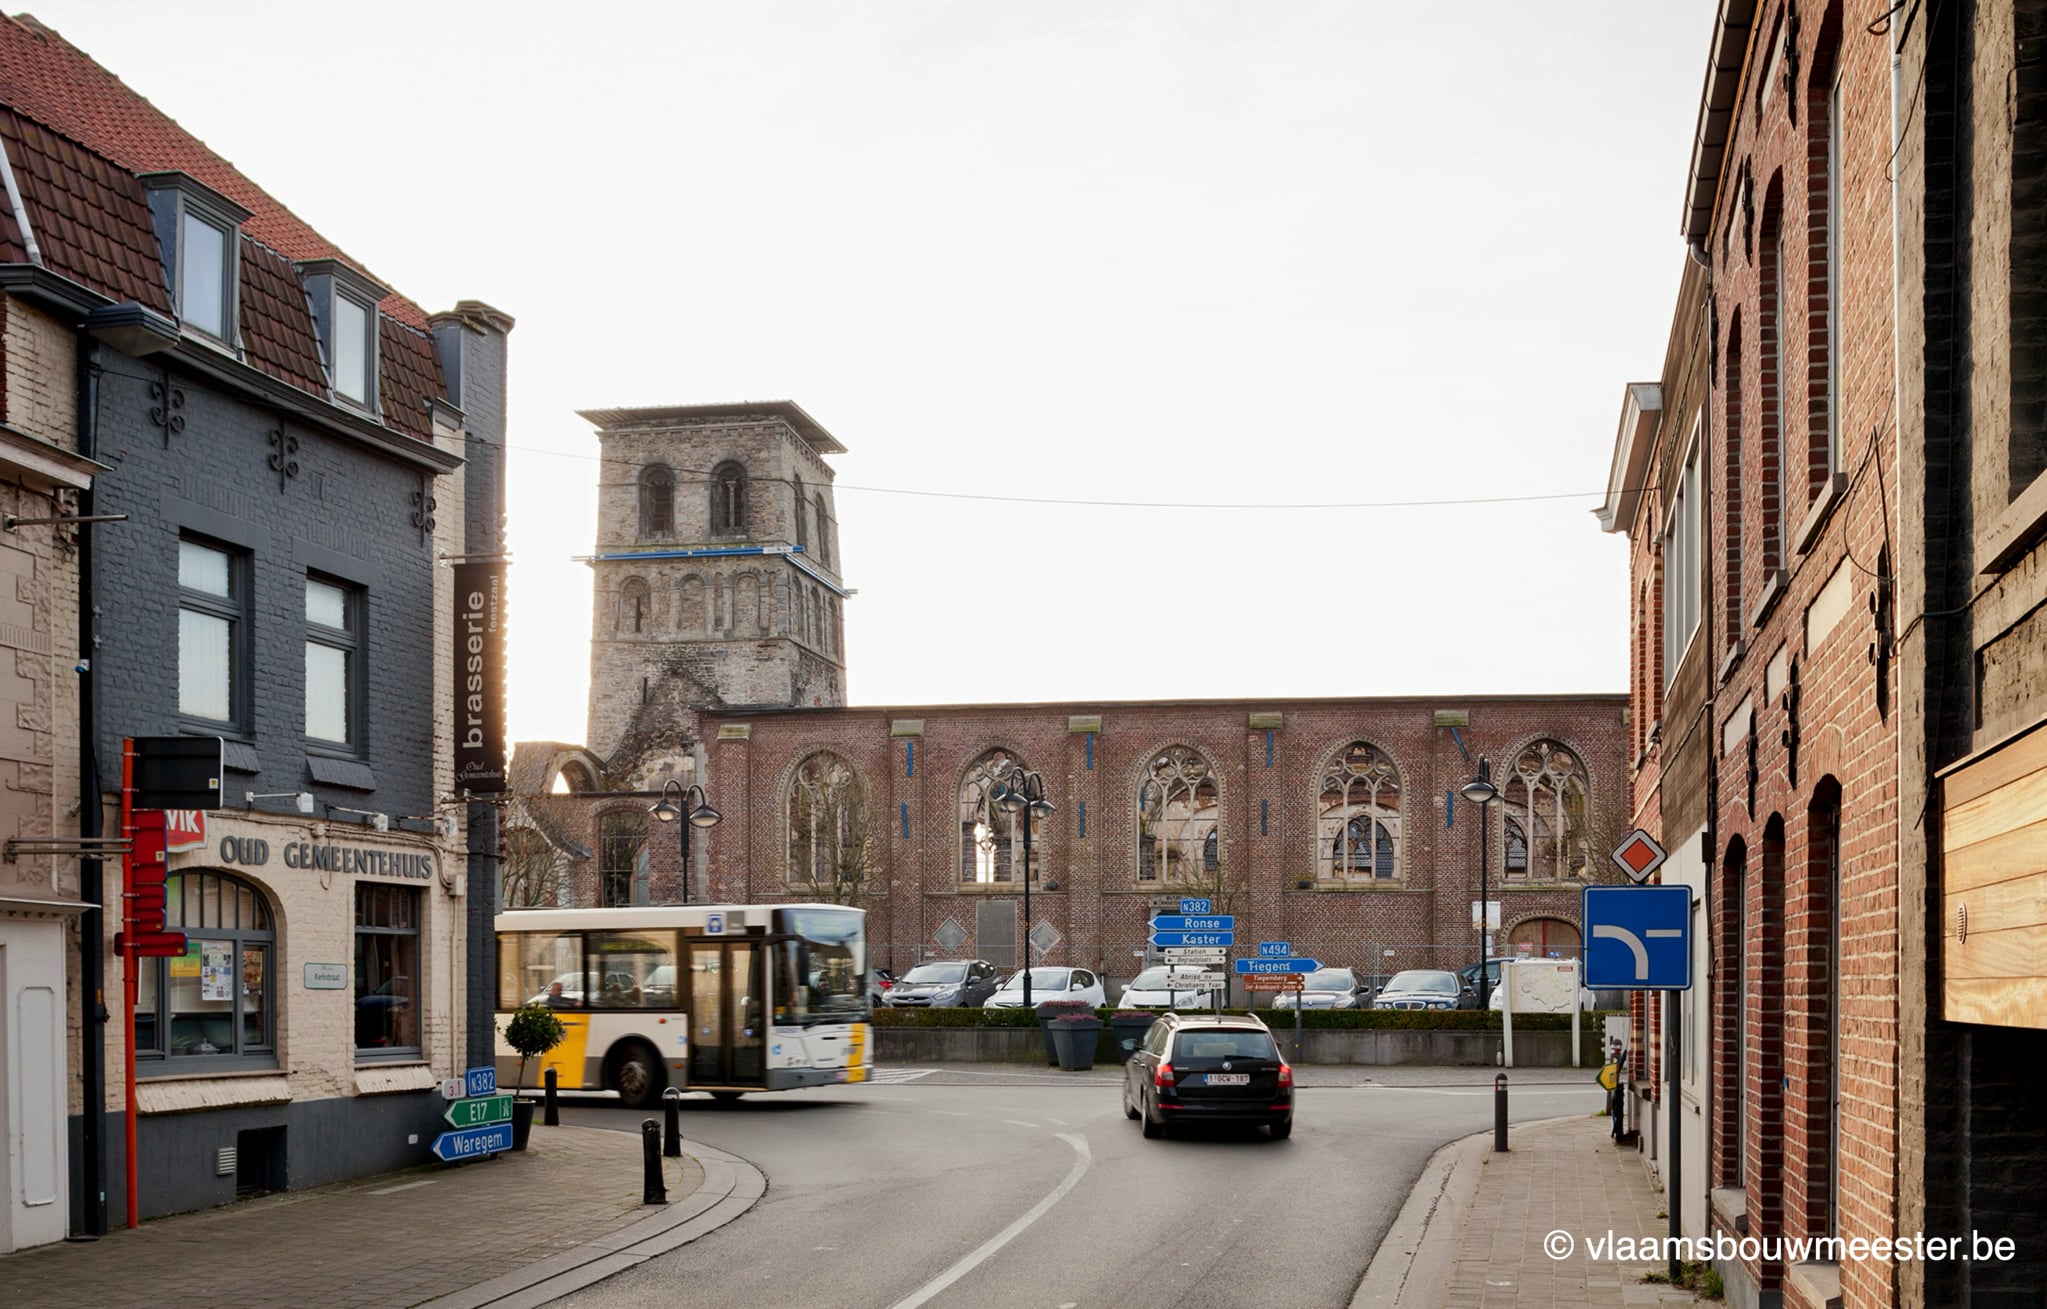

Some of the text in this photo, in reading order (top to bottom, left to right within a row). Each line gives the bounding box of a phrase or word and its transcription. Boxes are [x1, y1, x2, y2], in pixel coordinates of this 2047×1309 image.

[488, 575, 499, 634] feestzaal
[463, 591, 484, 749] brasserie
[166, 809, 201, 834] VIK
[221, 835, 433, 880] OUD GEMEENTEHUIS
[1183, 901, 1207, 912] N382
[1185, 918, 1220, 928] Ronse
[1182, 934, 1220, 944] Kaster
[1262, 945, 1287, 955] N494
[471, 1072, 494, 1093] N382
[470, 1102, 487, 1122] E17
[453, 1133, 503, 1155] Waregem
